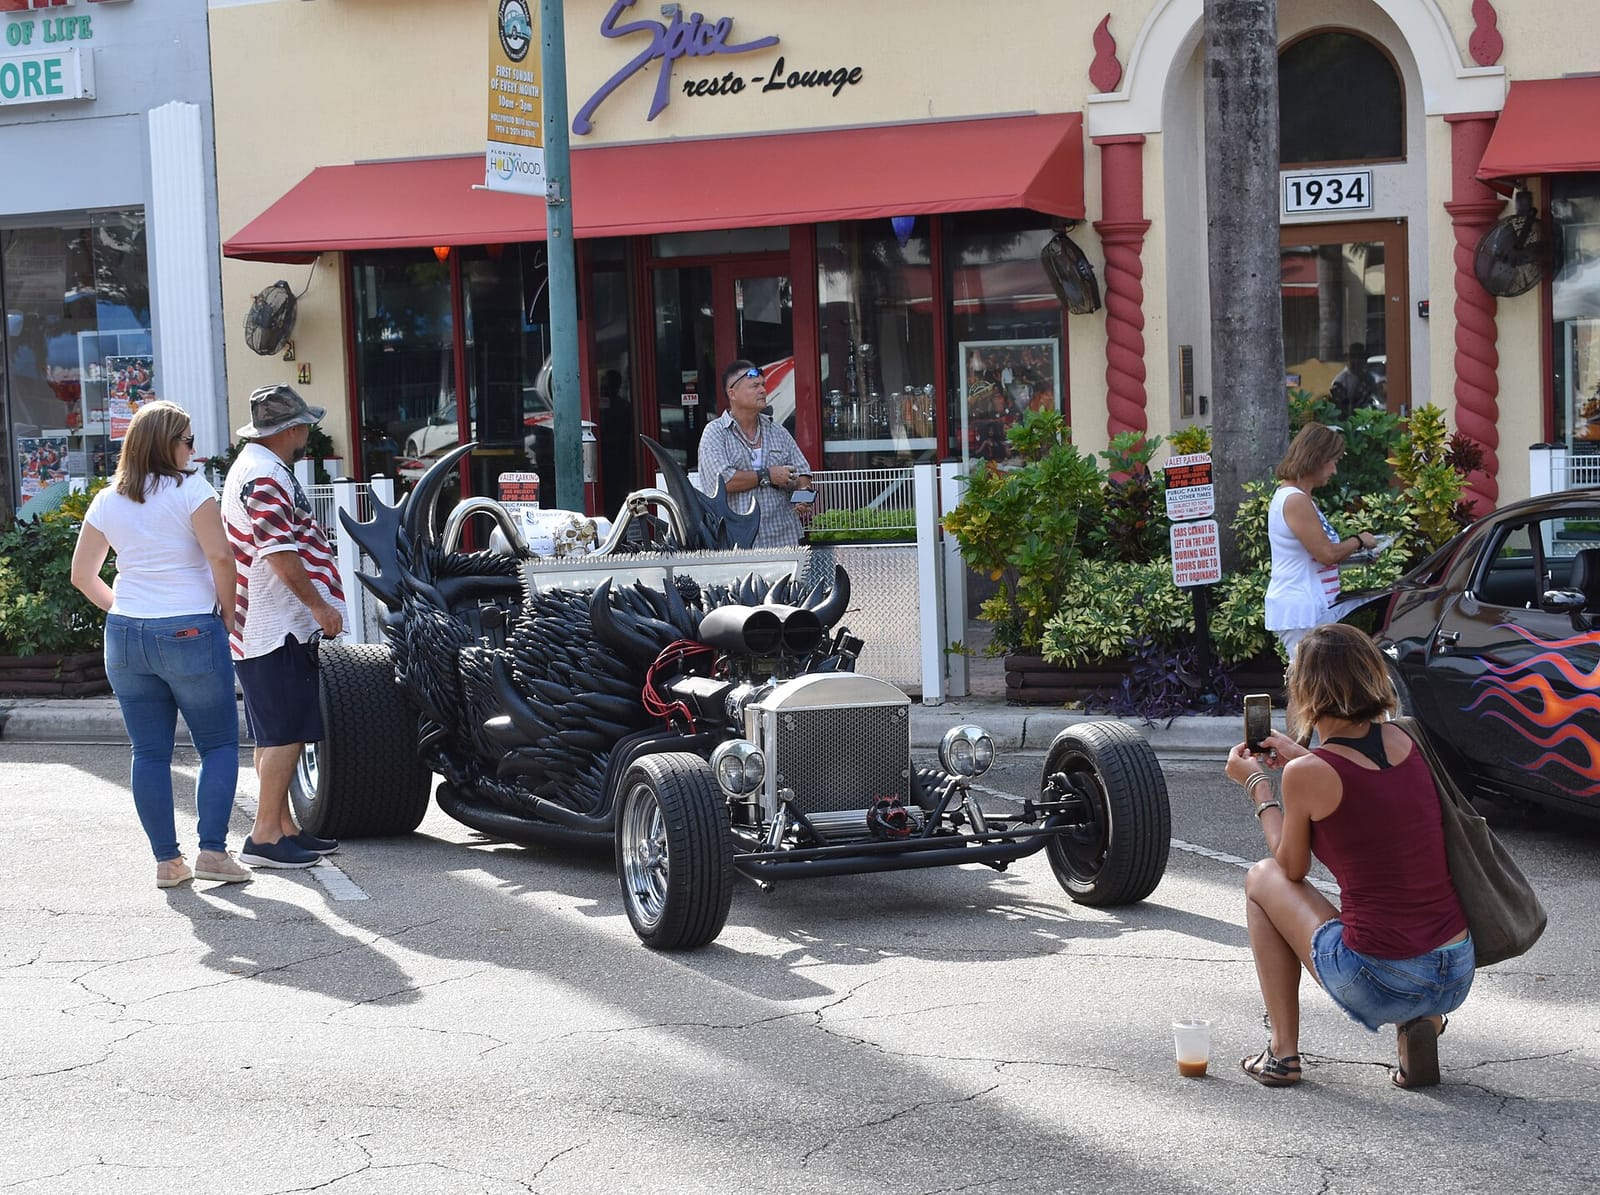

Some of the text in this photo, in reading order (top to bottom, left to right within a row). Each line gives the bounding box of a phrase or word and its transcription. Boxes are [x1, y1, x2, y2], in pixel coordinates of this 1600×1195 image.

[6, 16, 92, 46] OF LIFE
[496, 65, 534, 82] FIRST SUNDAY
[571, 0, 780, 135] Spice
[0, 58, 64, 98] ORE
[491, 78, 539, 97] OF EVERY MONTH
[499, 96, 514, 108] 10am
[520, 99, 533, 112] 3pm
[491, 157, 540, 178] HOLLYWOOD
[1291, 177, 1364, 206] 1934
[1164, 455, 1210, 466] VALET PARKING
[1188, 525, 1207, 535] CANNOT
[1208, 524, 1215, 533] BE
[1175, 539, 1184, 548] LEFT
[1193, 537, 1201, 546] THE
[1175, 547, 1216, 560] DURING VALET
[1176, 558, 1217, 571] HOURS DUE TO
[1176, 570, 1219, 582] CITY ORDINANCE
